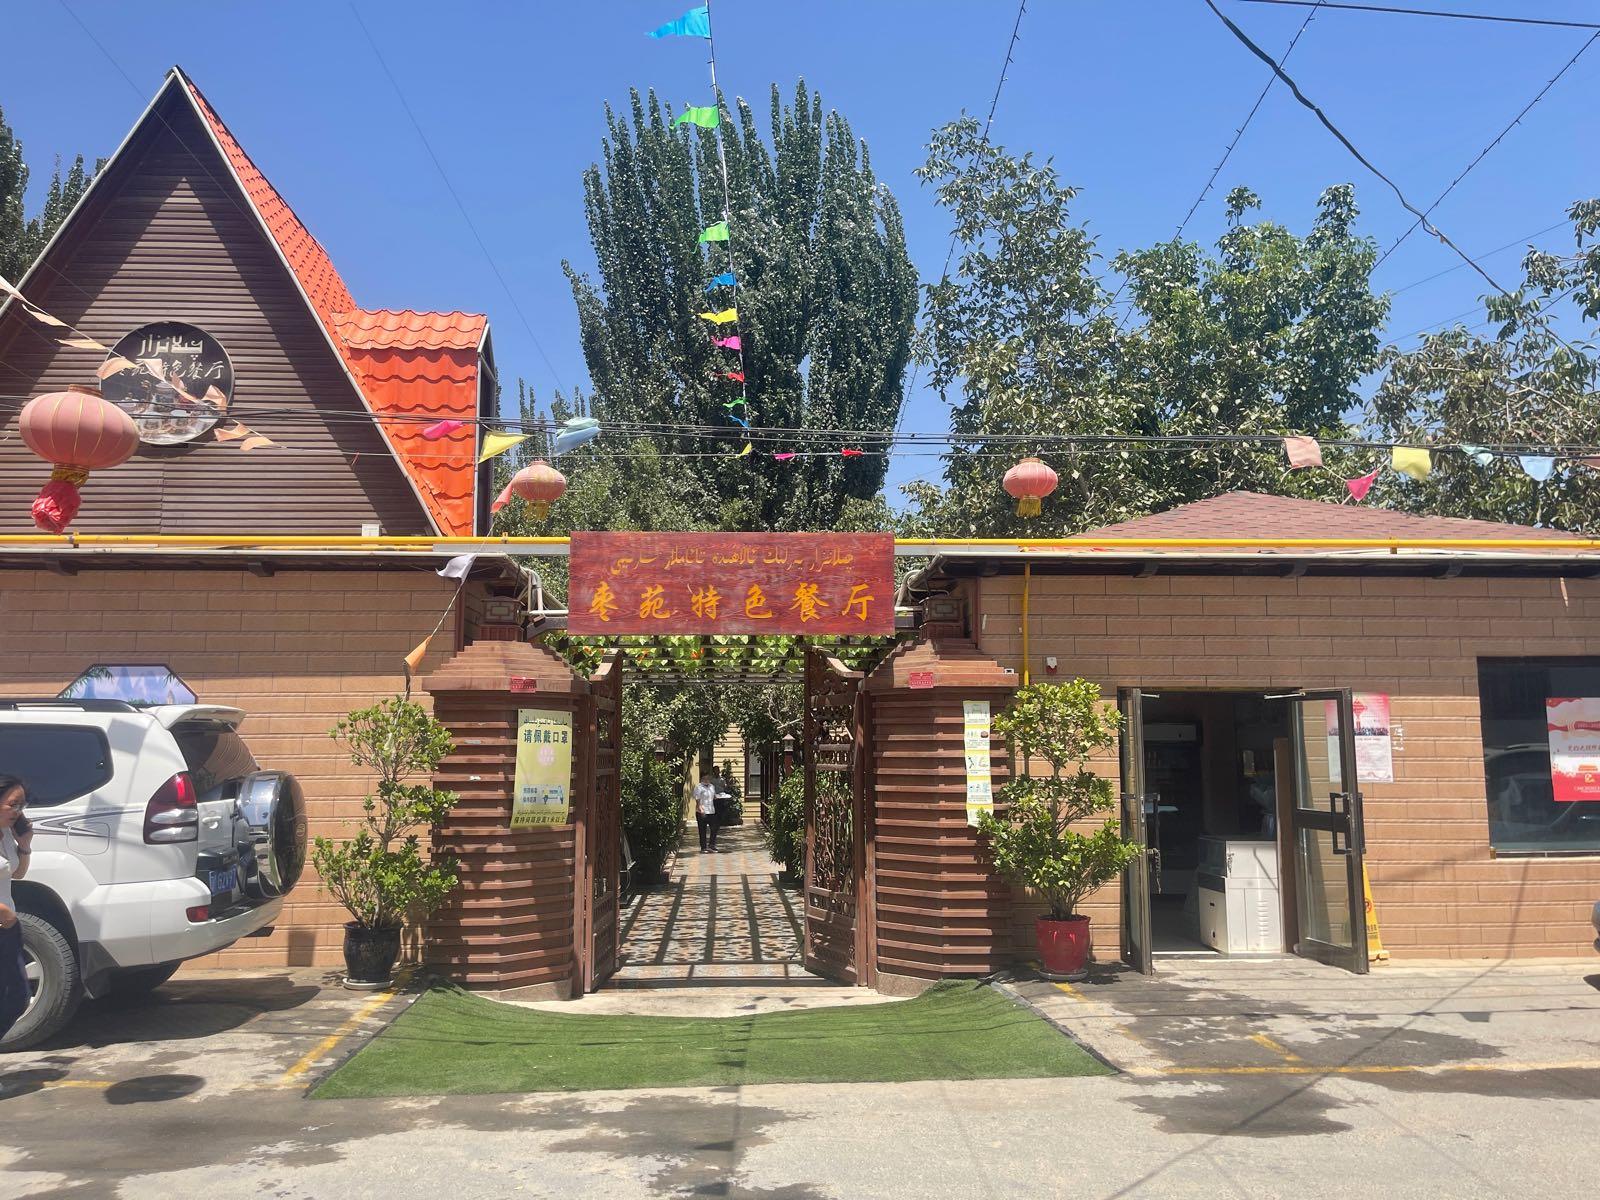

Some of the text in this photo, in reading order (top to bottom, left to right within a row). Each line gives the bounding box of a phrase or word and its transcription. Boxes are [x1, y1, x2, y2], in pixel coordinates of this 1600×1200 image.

[117, 359, 225, 380] 苑色餐厅
[588, 581, 875, 622] 枣苑特色餐厅
[523, 729, 568, 745] 请佩戴口罩
